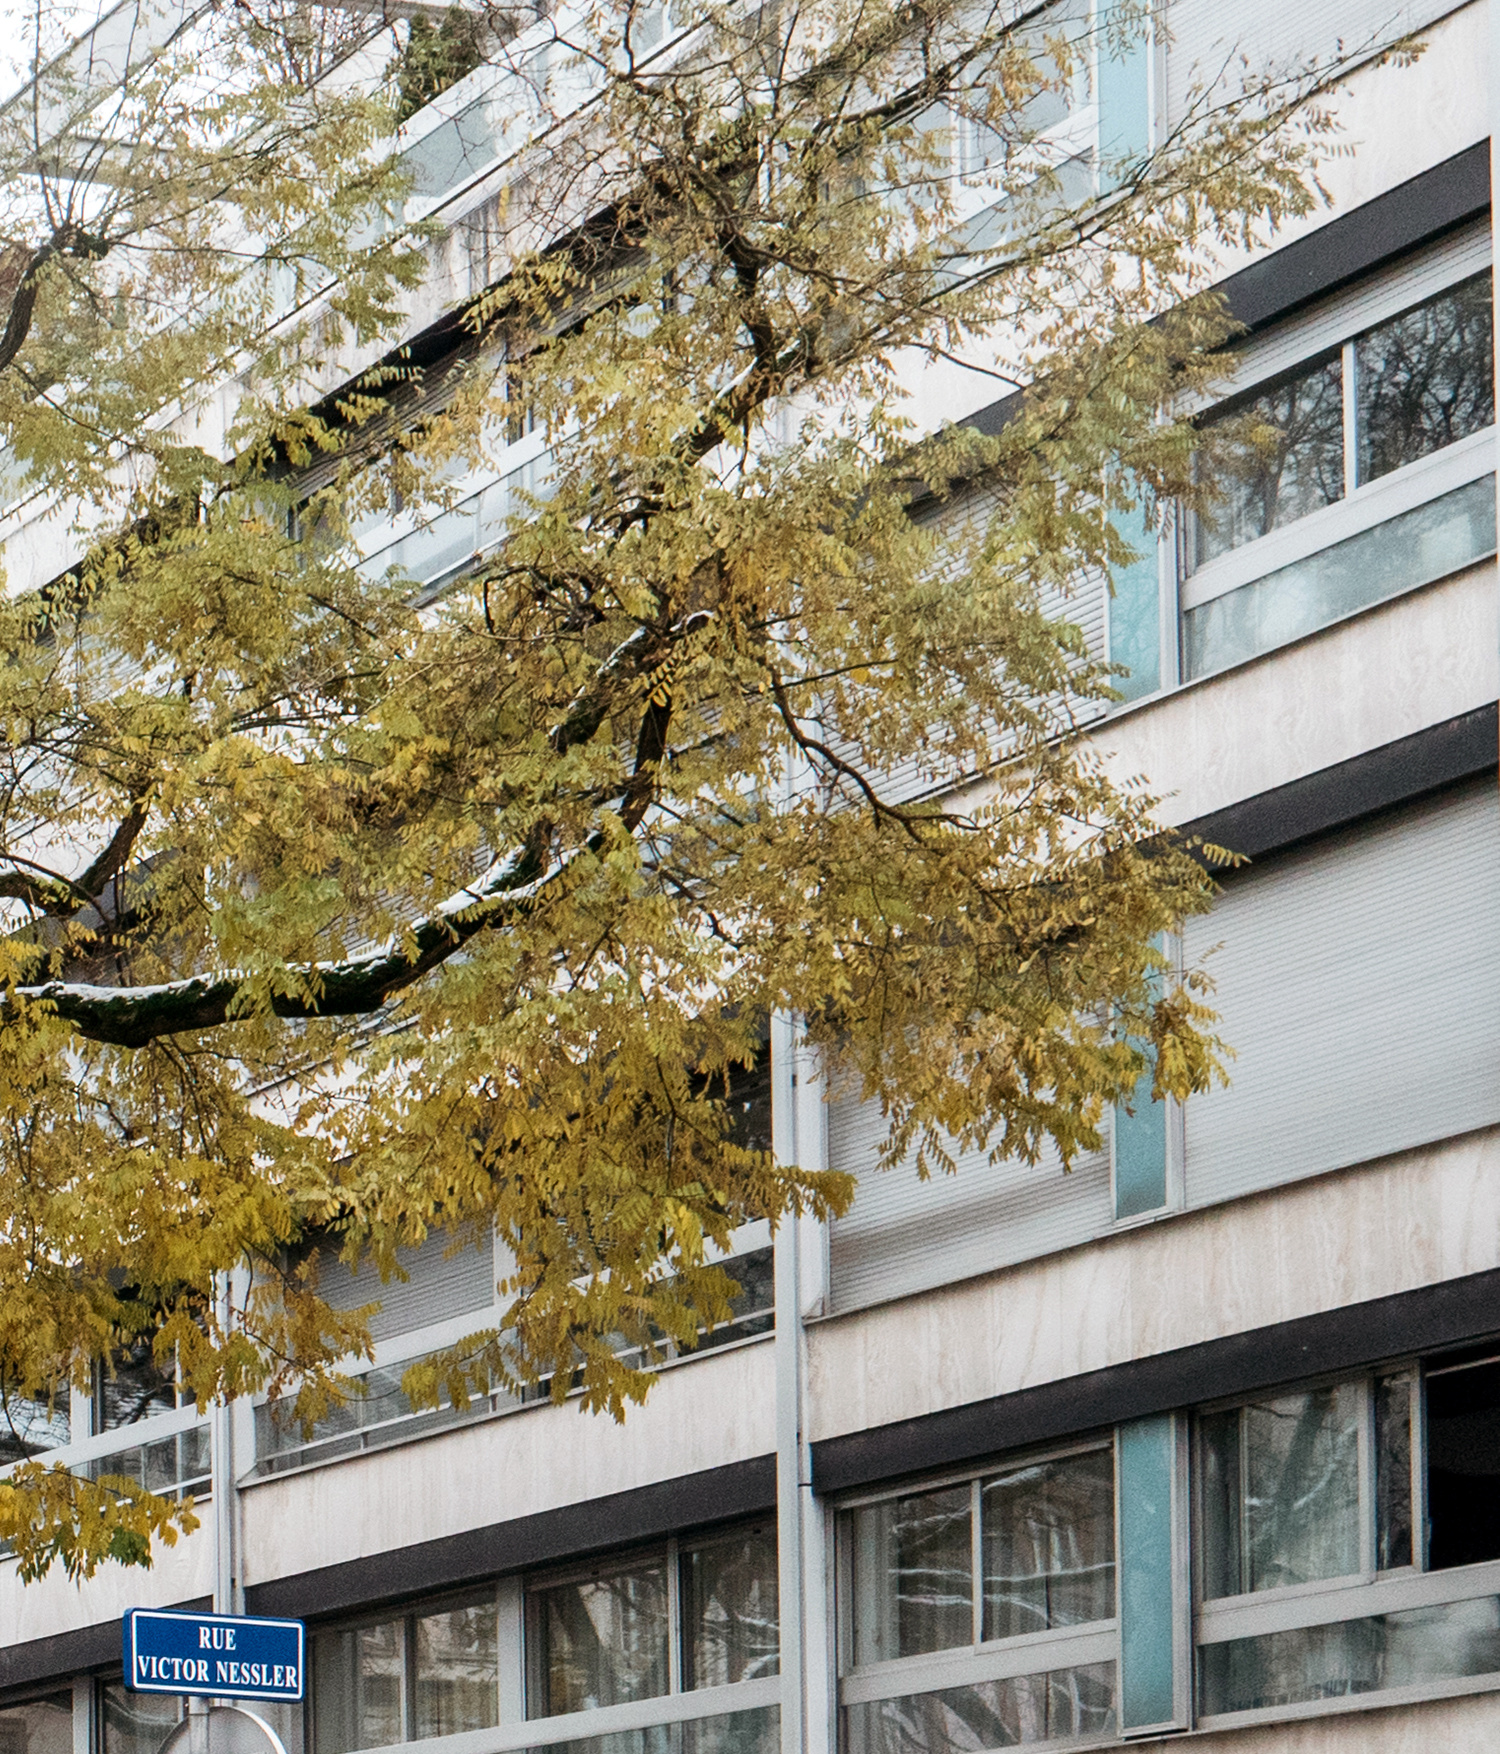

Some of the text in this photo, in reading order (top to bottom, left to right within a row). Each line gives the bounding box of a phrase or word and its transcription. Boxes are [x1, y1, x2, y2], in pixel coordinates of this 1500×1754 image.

[198, 1626, 236, 1651] RUE
[137, 1655, 298, 1688] VICTOR NESSLER
